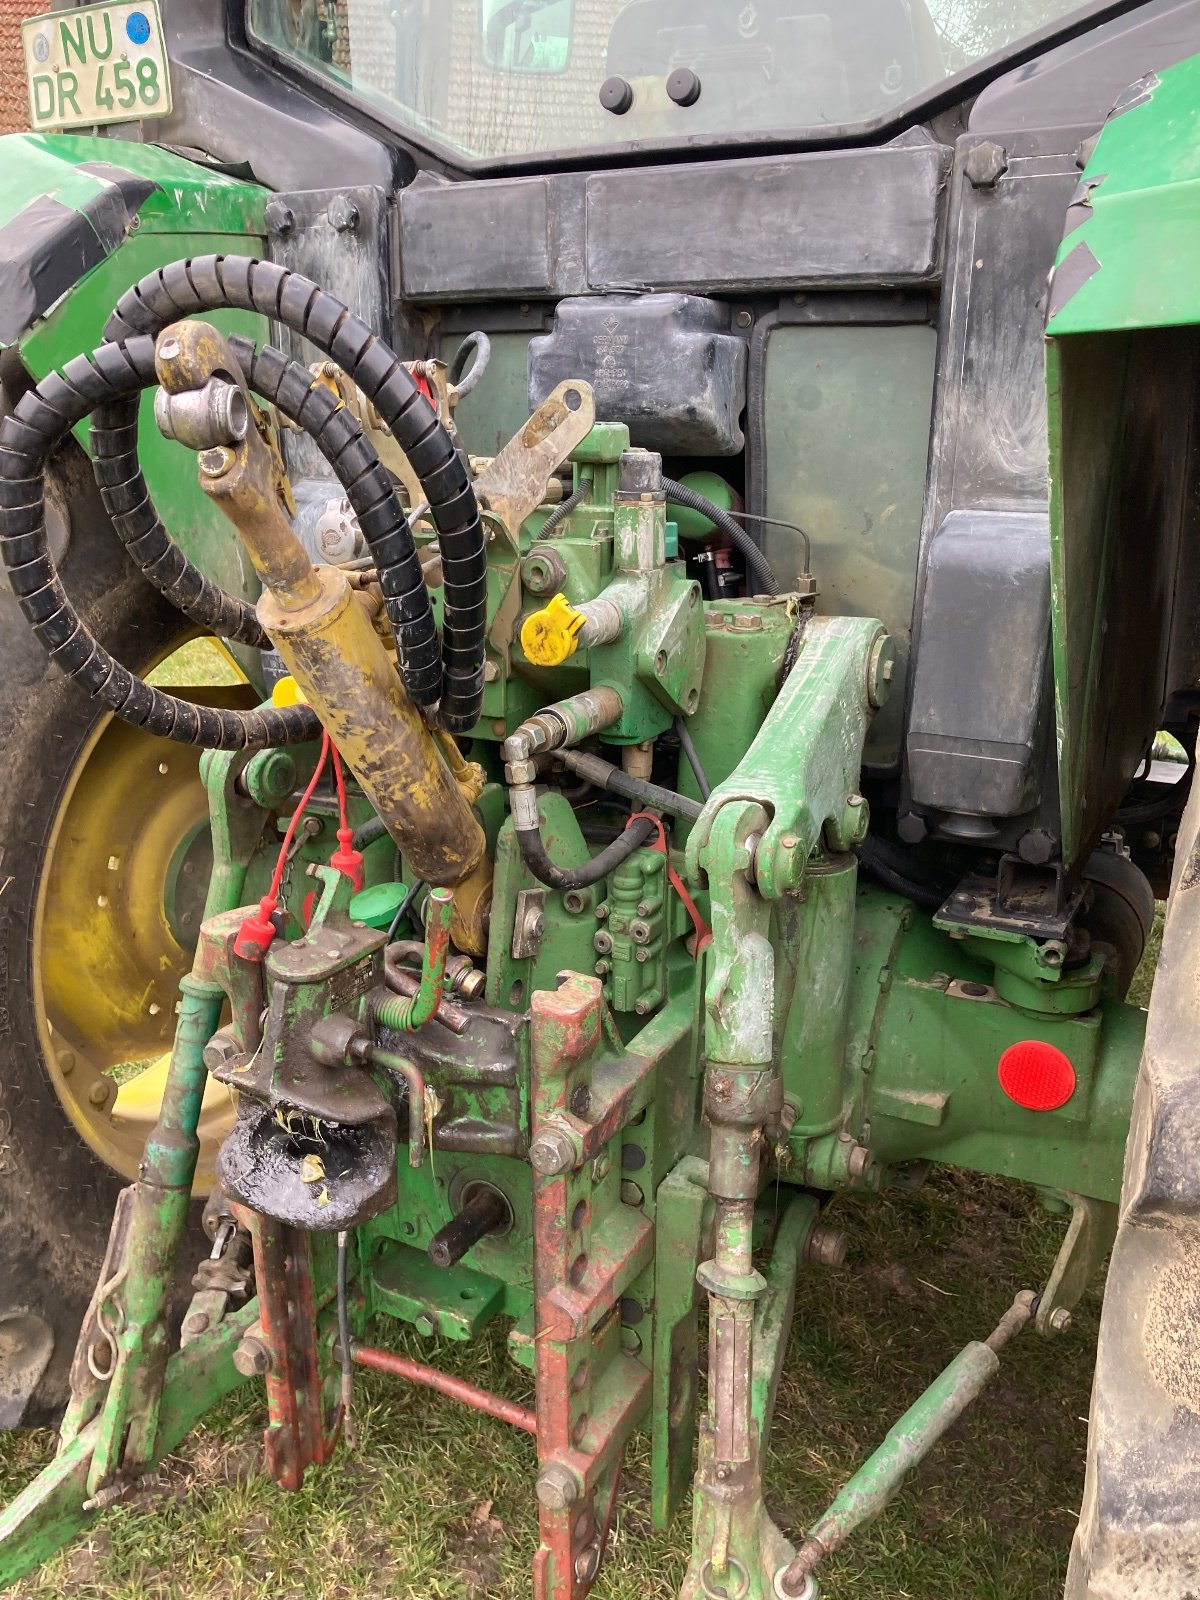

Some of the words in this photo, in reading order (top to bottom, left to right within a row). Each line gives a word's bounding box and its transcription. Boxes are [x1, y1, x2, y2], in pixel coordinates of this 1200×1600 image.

[60, 12, 113, 66] NU
[33, 71, 81, 120] DR
[96, 57, 160, 110] 458
